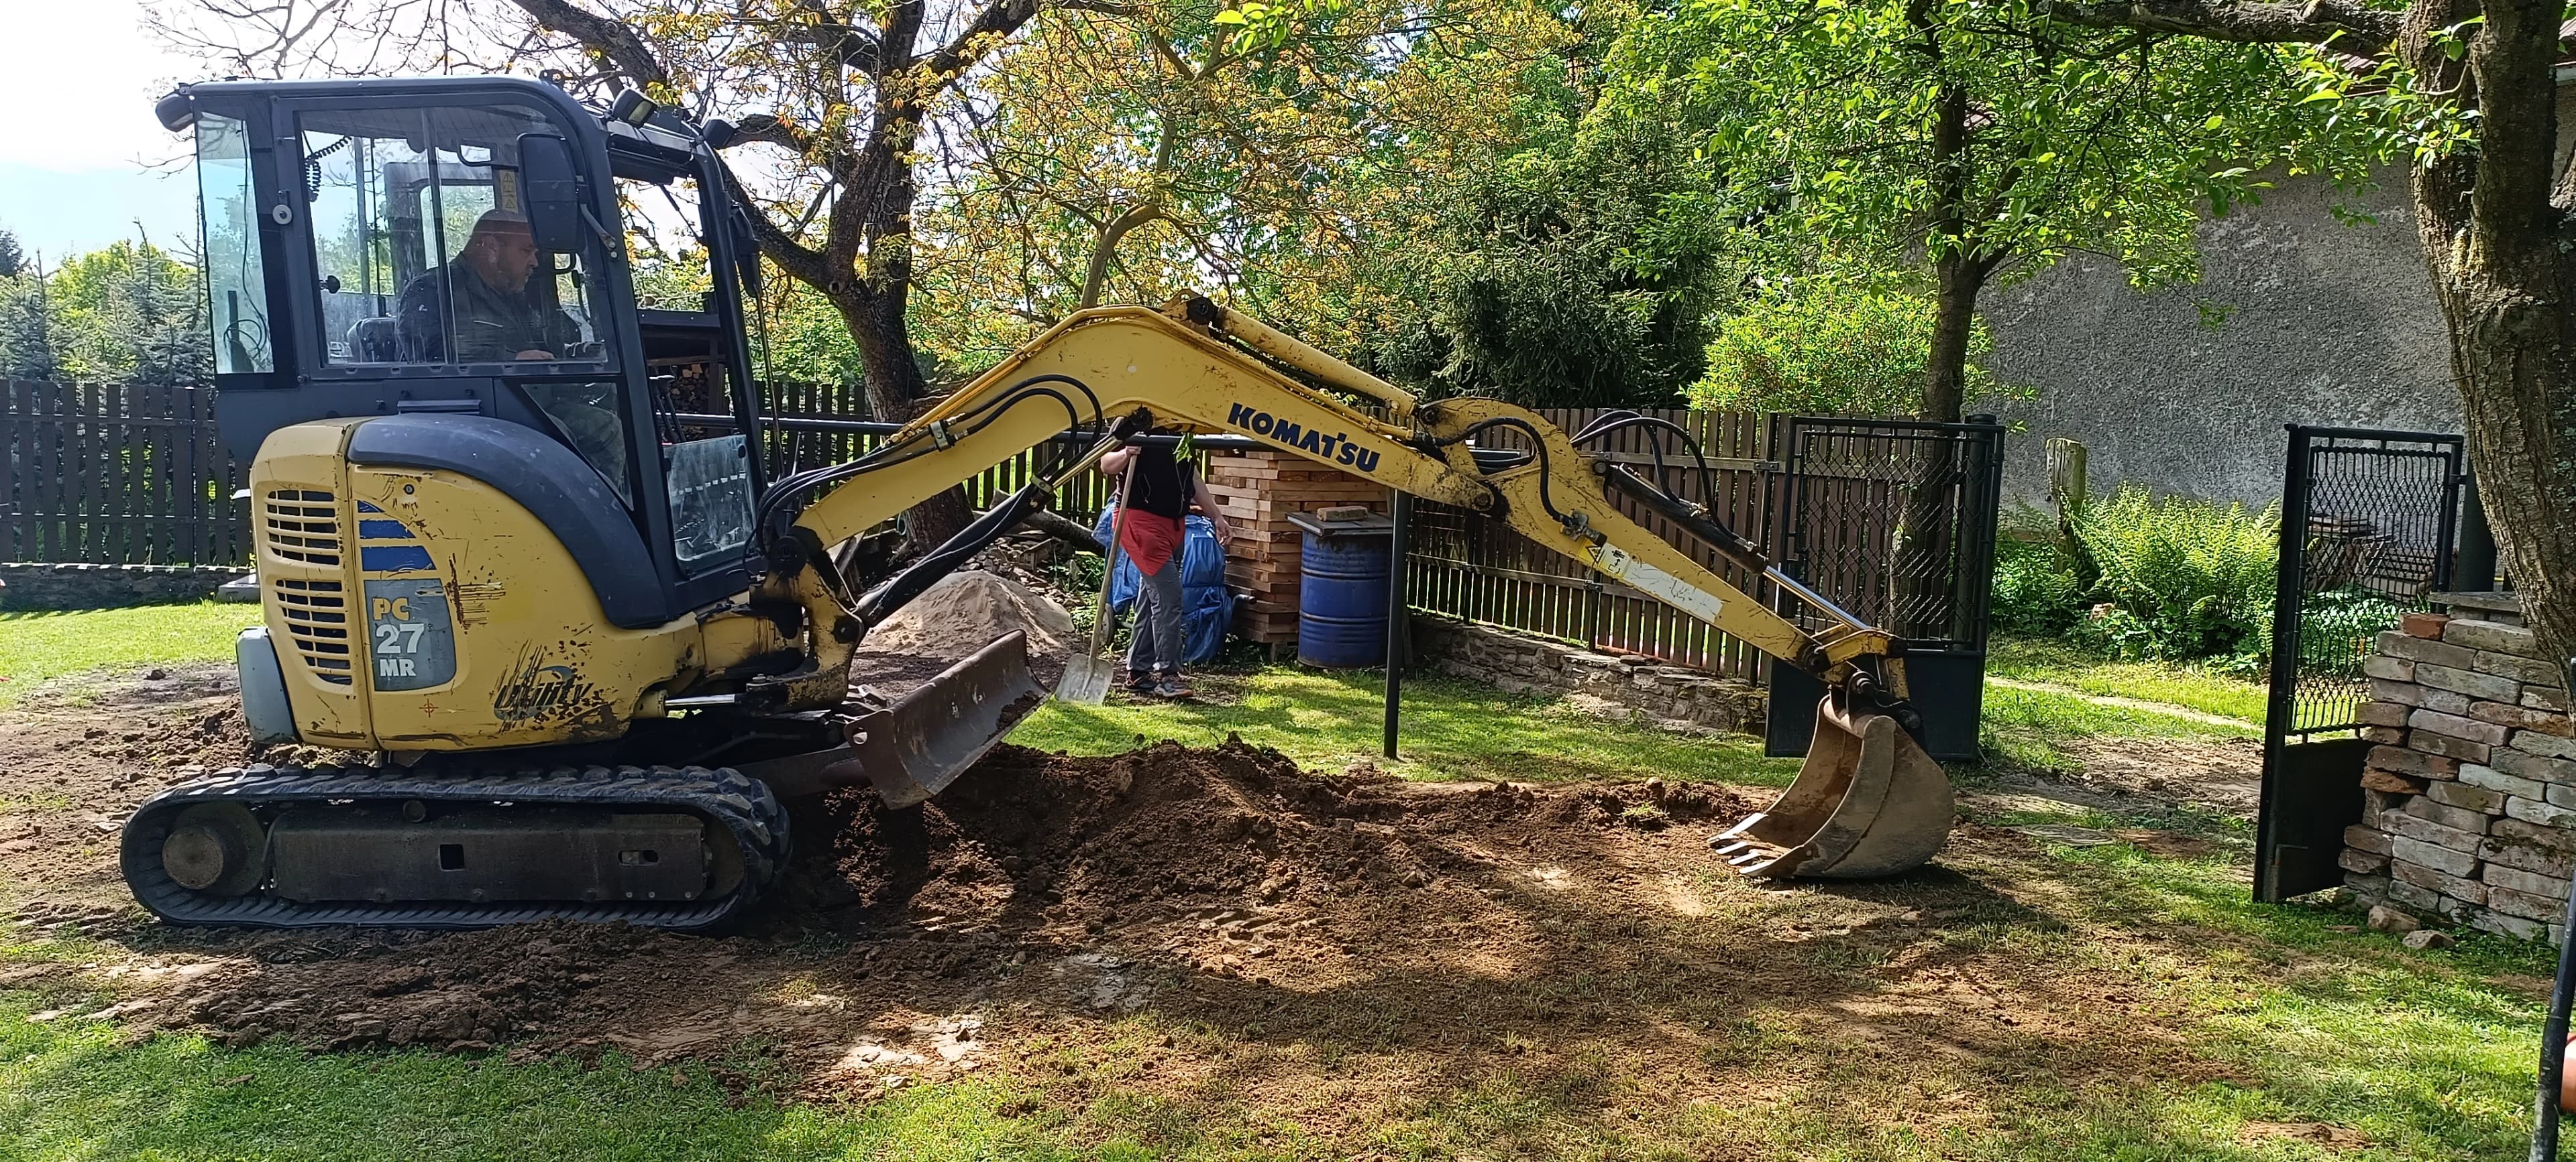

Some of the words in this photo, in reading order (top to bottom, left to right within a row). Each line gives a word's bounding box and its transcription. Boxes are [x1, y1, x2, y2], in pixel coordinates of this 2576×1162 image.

[1227, 403, 1381, 472] KOMATSU
[372, 597, 410, 621] PC
[376, 623, 425, 653] 27
[380, 659, 417, 676] MR
